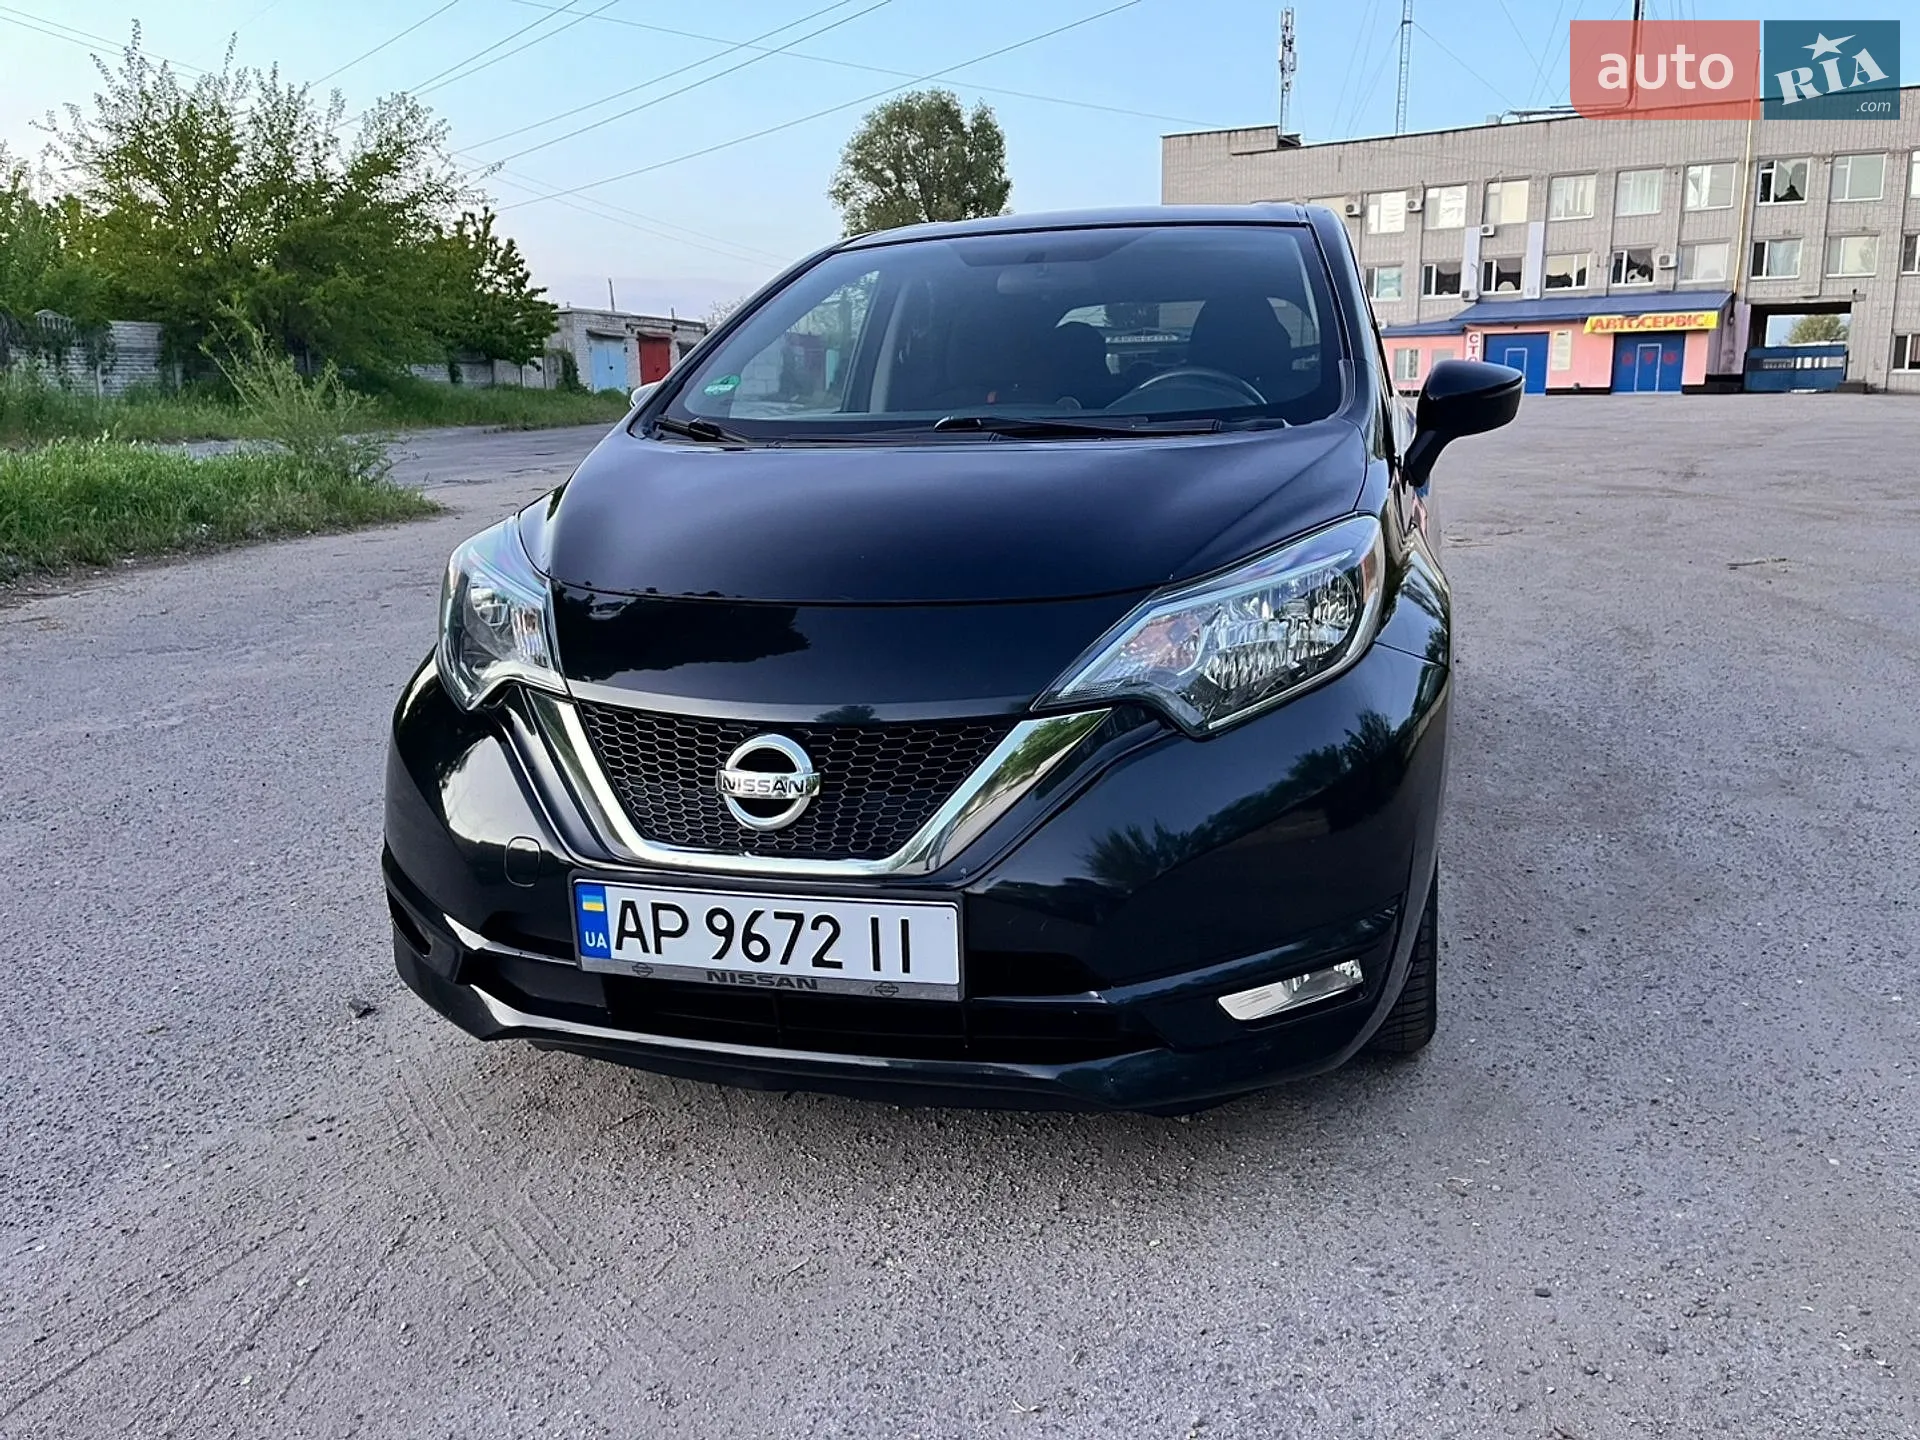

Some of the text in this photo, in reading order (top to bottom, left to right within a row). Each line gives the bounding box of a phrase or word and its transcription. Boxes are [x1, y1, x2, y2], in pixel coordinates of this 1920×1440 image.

[721, 775, 804, 793] NISSAN
[585, 931, 608, 949] UA
[614, 899, 690, 955] AP
[704, 906, 844, 970] 9672
[706, 970, 818, 991] NISSAN
